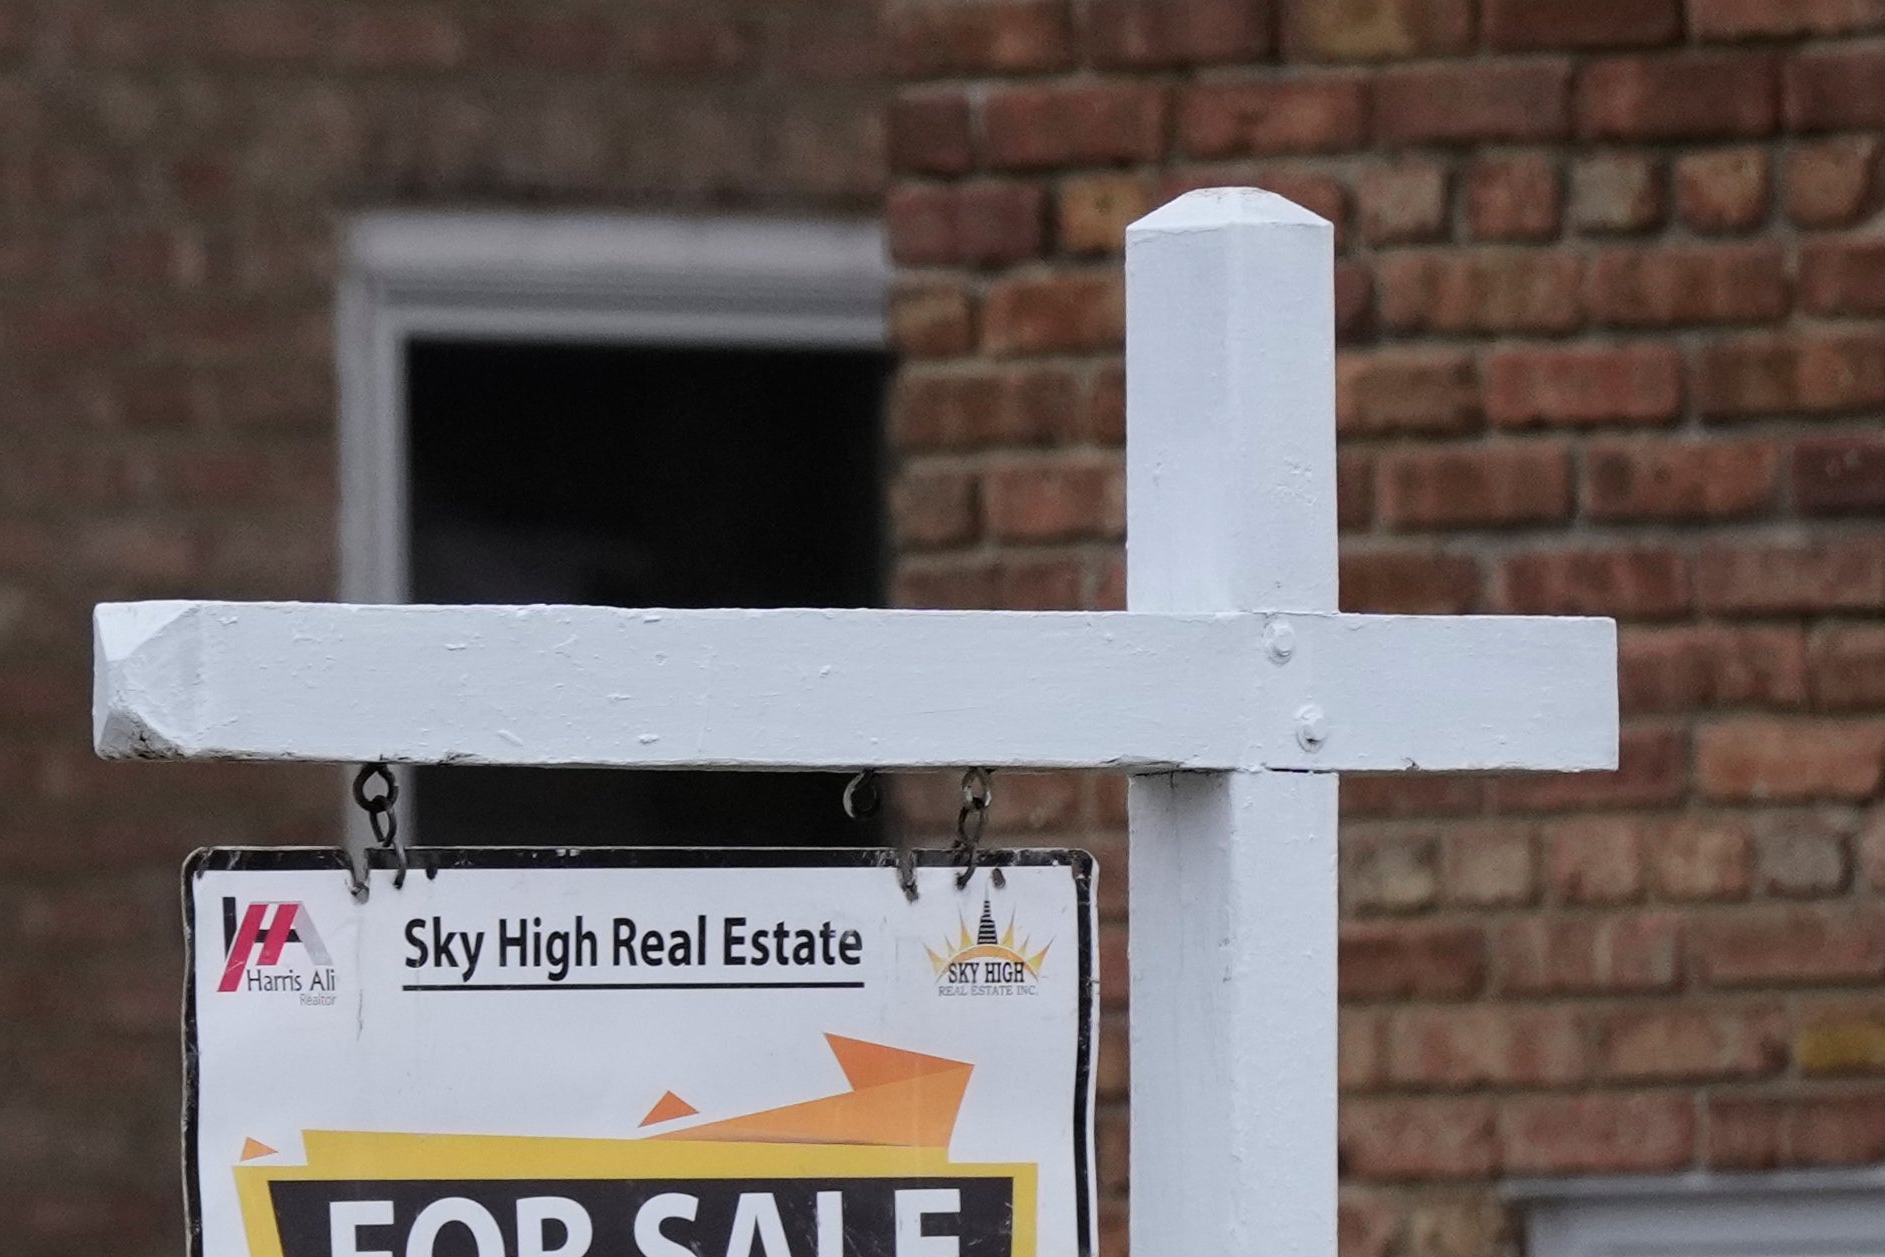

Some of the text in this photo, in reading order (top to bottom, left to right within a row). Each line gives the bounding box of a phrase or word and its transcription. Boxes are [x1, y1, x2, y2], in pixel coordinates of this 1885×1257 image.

[403, 913, 864, 982] Sky High Real Estate
[246, 969, 336, 992] Harris Ali
[948, 961, 1025, 984] SKY HIGH
[299, 993, 337, 1006] Realtor
[938, 985, 1039, 997] REAL ESTATE INC.
